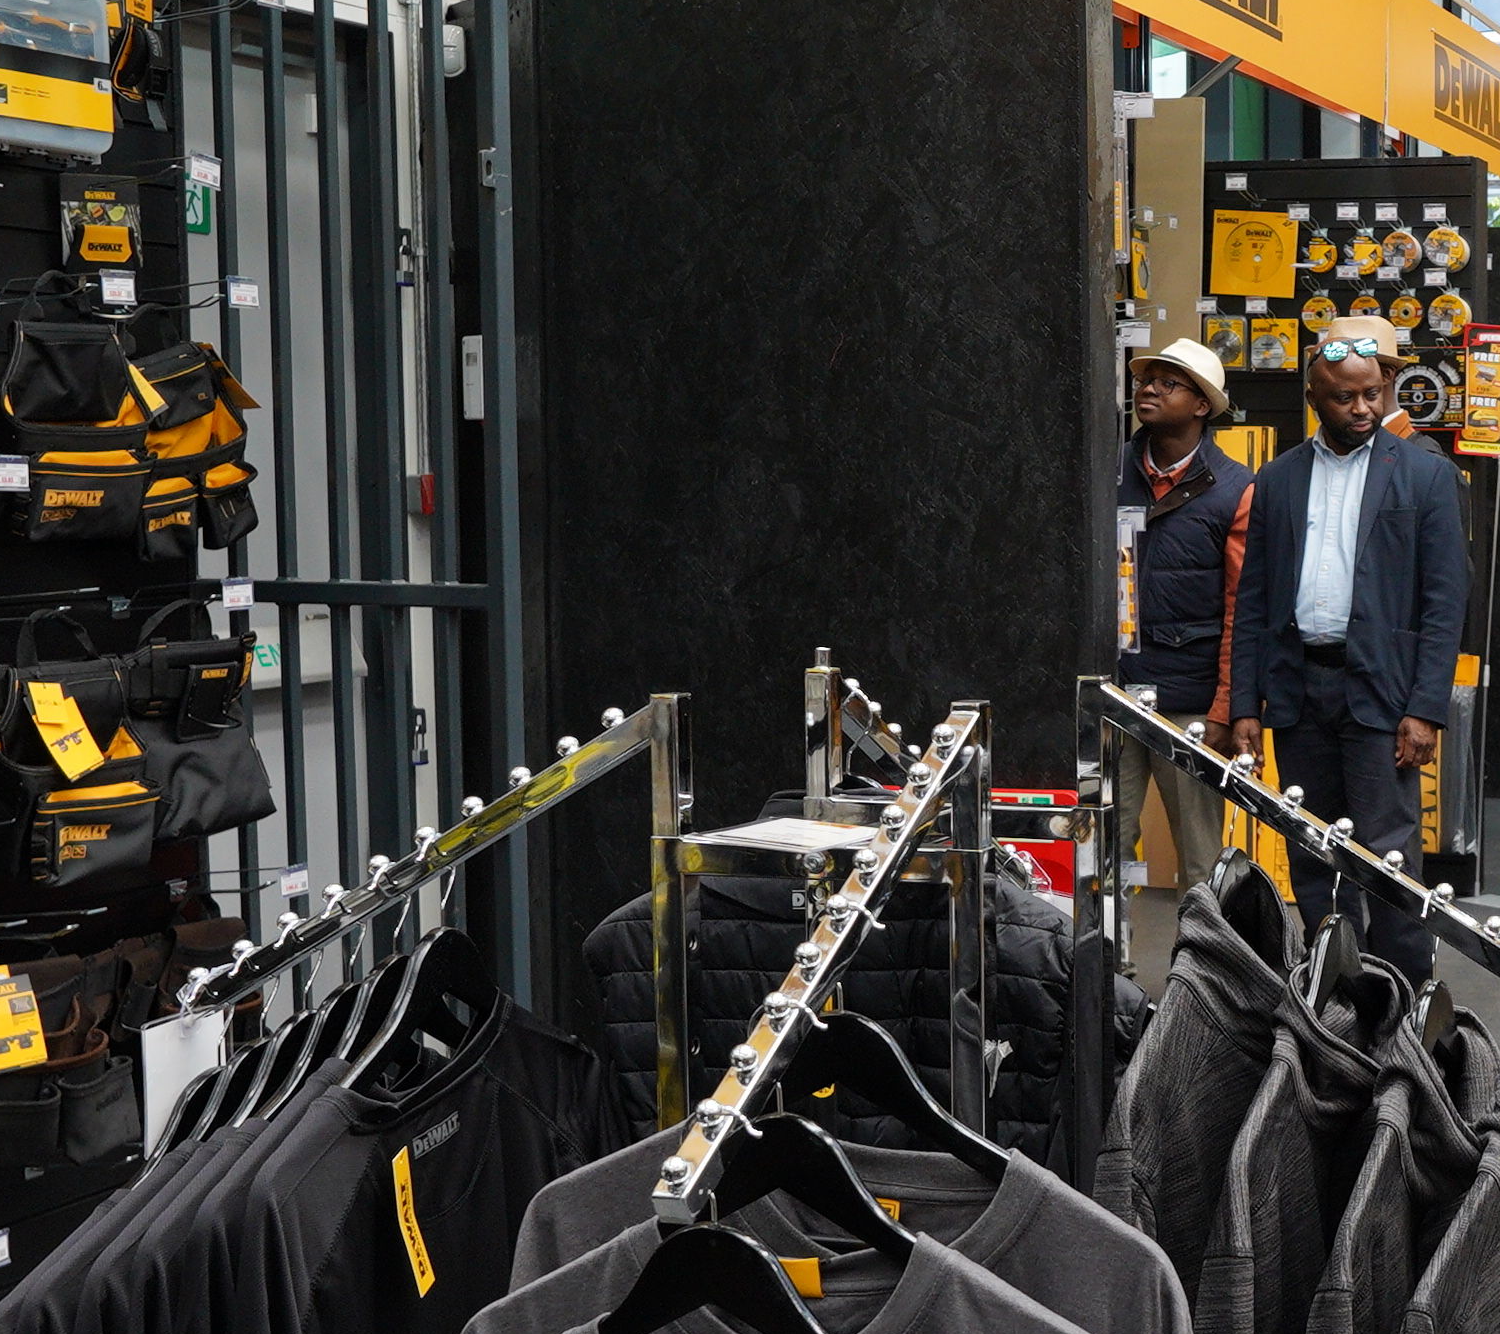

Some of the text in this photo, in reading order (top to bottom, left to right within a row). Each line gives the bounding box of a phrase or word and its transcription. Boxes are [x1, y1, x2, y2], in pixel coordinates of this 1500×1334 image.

[84, 190, 116, 201] DEWALT
[1246, 229, 1273, 239] DEWALT
[88, 242, 123, 253] DEWALT
[1473, 352, 1500, 363] FREE
[1470, 397, 1497, 408] FREE
[45, 489, 104, 508] DEWALT
[412, 1113, 460, 1159] DEWALT
